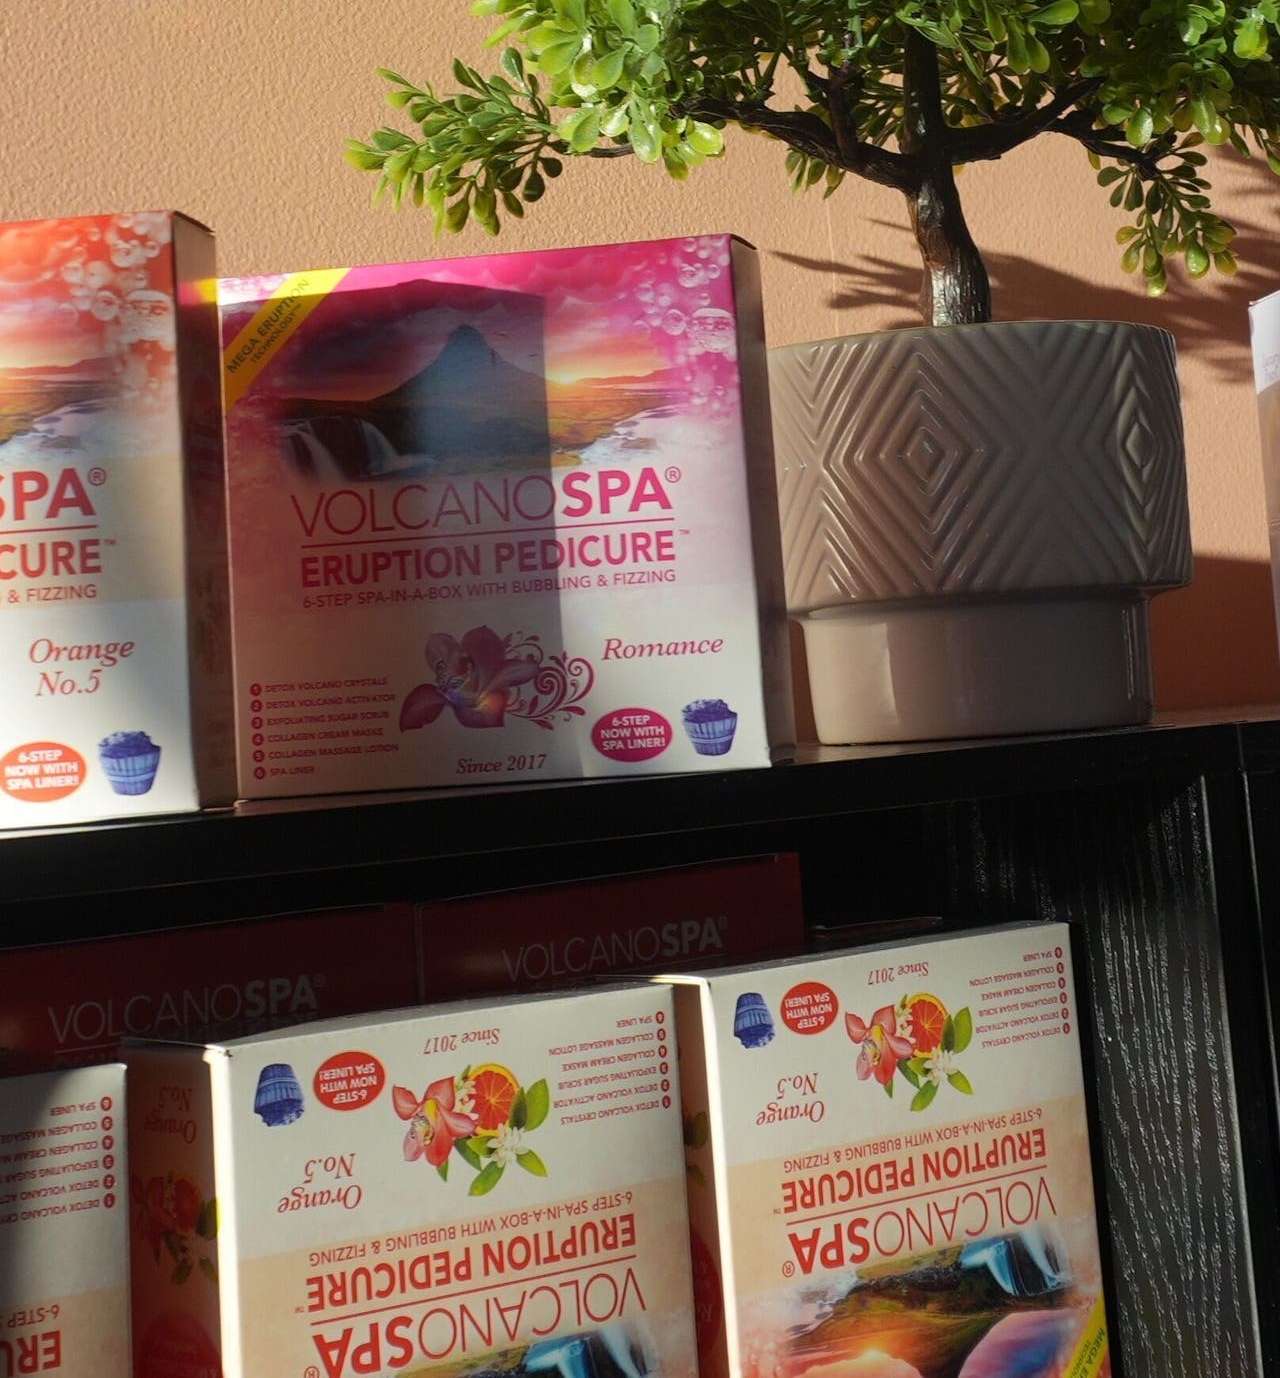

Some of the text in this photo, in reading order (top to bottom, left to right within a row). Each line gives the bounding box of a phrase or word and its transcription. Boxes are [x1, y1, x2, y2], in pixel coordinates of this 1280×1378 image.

[301, 544, 483, 588] ERUPTION
[7, 589, 21, 605] &
[26, 583, 98, 604] FIZZING
[303, 569, 677, 610] 6-STEP SPA-IN-A-BOX WITH BUBBLING & FIZZING
[28, 637, 136, 668] Orange
[599, 629, 724, 662] Romance
[35, 668, 103, 699] No.5
[599, 724, 665, 739] NOW WITH
[610, 712, 651, 726] 6-STEP
[18, 747, 64, 763] 6-STEP
[601, 736, 666, 751] SPA LINER!
[5, 760, 79, 777] NOW WITH
[455, 752, 548, 775] Since 2017
[6, 774, 80, 791] SPA LINER!
[866, 960, 931, 986] Since 2017
[784, 990, 831, 1008] SPA LINER!
[785, 1001, 833, 1019] NOW WITH
[796, 1014, 825, 1030] 6-STEP
[420, 1026, 500, 1056] Since 2017
[317, 1061, 375, 1081] SPA LINER!
[318, 1073, 377, 1094] NOW WITH
[331, 1087, 368, 1105] 6-STEP
[776, 1070, 817, 1100] No.5
[755, 1100, 824, 1126] Orange
[782, 1106, 1043, 1174] 6-STEP SPA-IN-A-BOX WITH BUBBLING & FIZZING
[302, 1150, 356, 1185] No.5
[922, 1127, 1046, 1183] ERUPTION
[276, 1184, 363, 1214] Orange
[308, 1189, 633, 1268] 6-STEP SPA-IN-A-BOX WITH BUBBLING & FIZZING
[481, 1212, 636, 1276] ERUPTION
